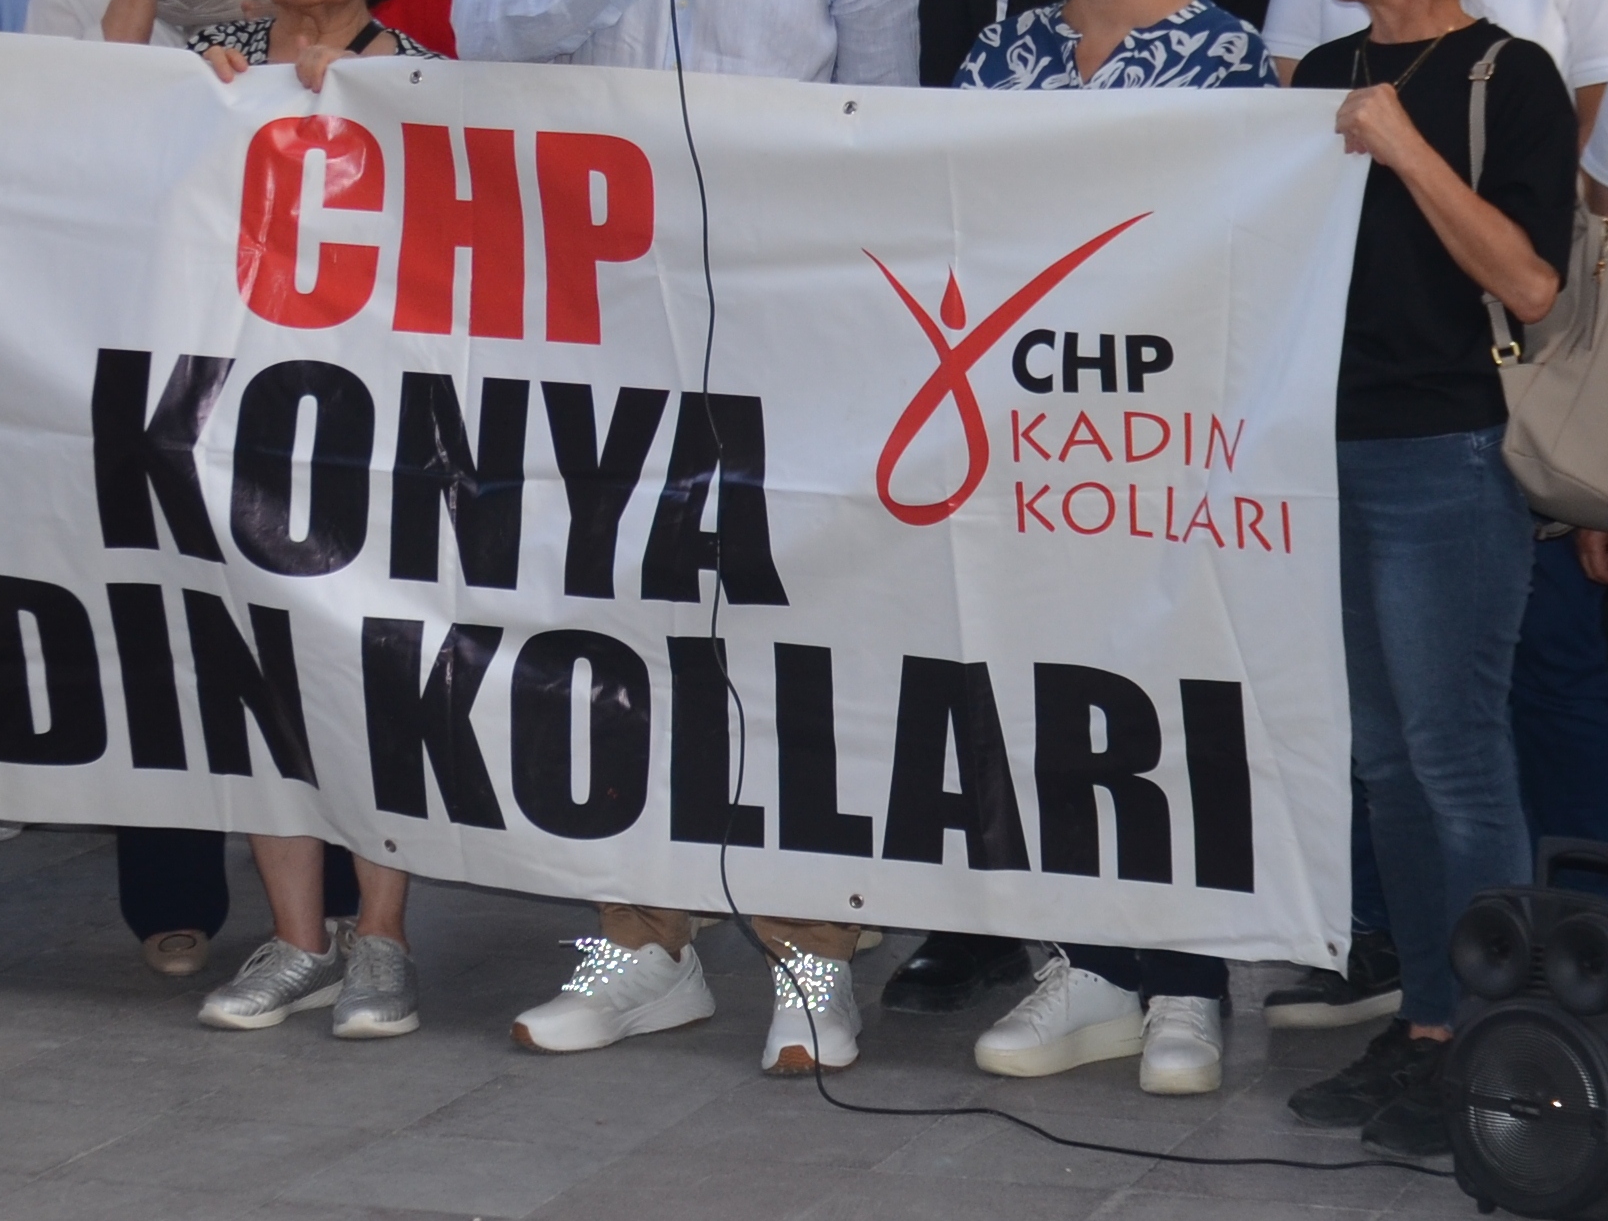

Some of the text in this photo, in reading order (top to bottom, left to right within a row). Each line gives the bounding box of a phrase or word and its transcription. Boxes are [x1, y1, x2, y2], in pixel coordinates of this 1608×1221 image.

[237, 114, 656, 346] CHP
[1011, 328, 1175, 394] CHP
[92, 347, 791, 608] KONYA
[1010, 409, 1246, 474] KADIN
[1015, 480, 1293, 556] KOLLARI
[361, 616, 1256, 895] KOLLARI
